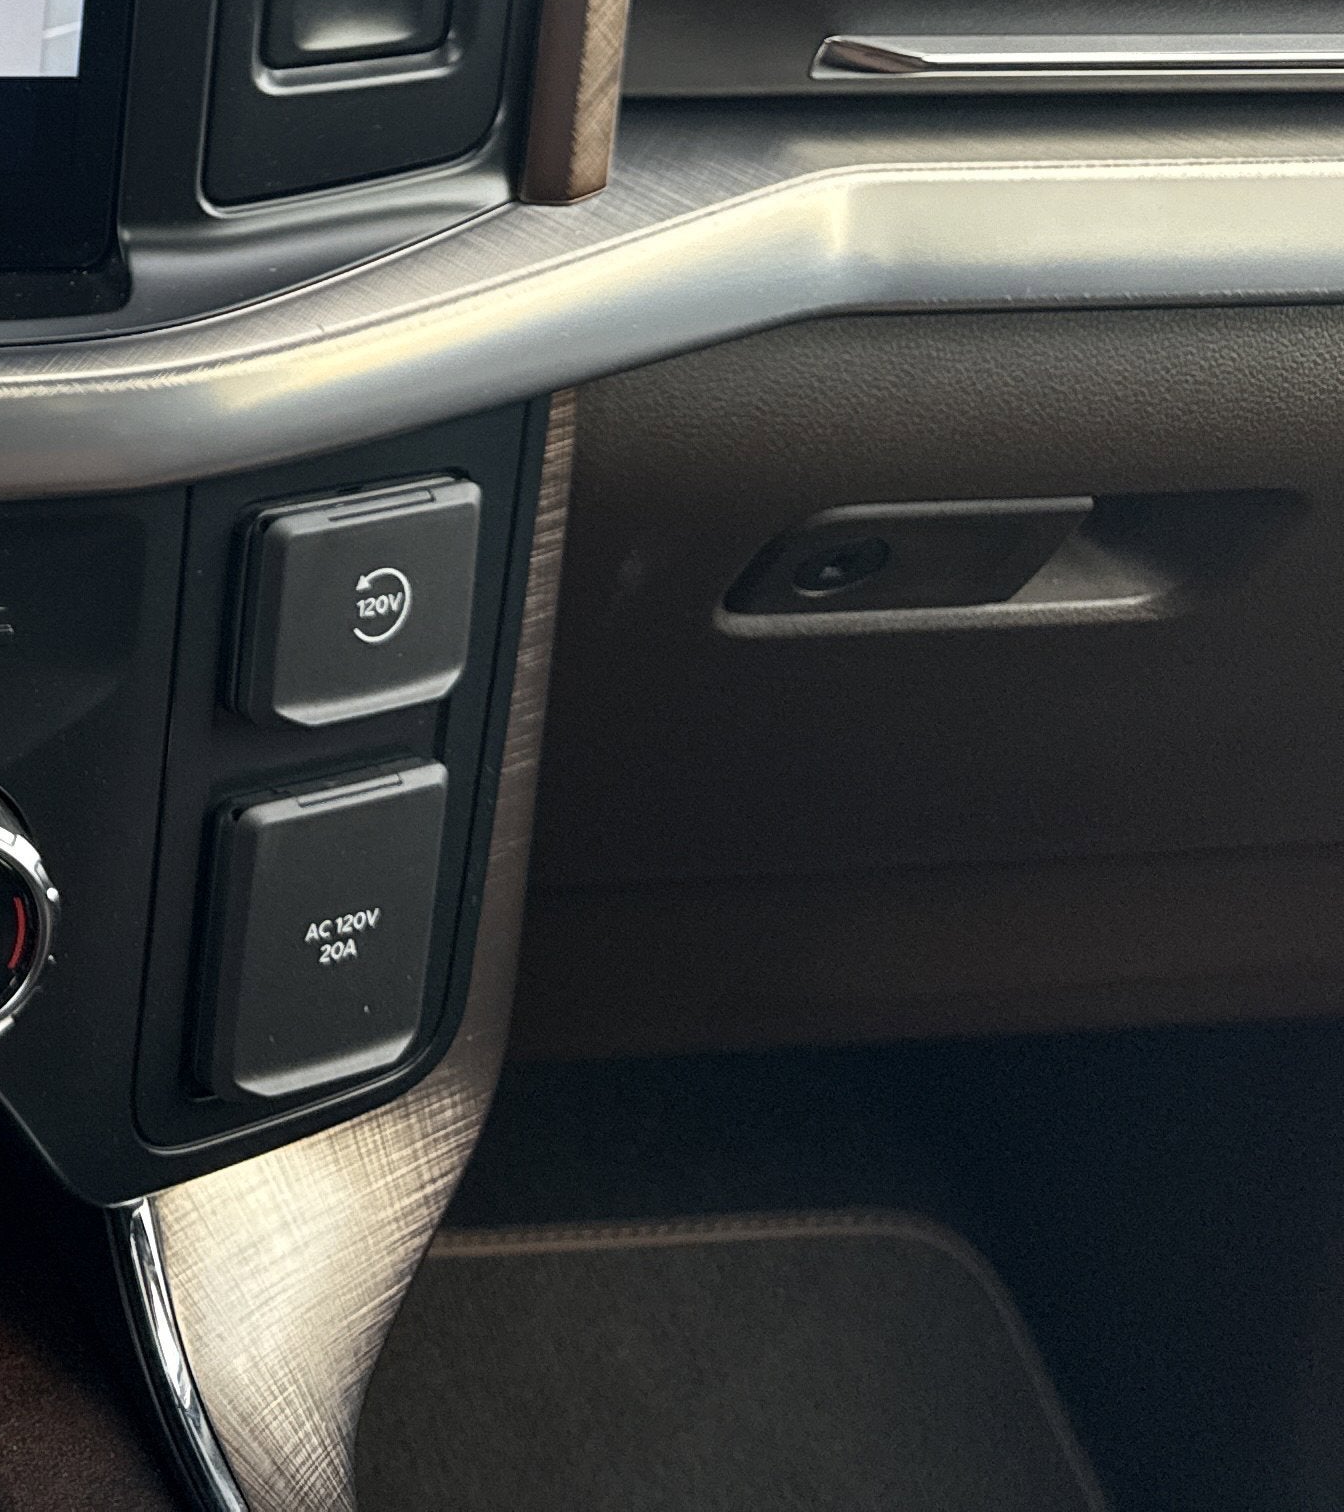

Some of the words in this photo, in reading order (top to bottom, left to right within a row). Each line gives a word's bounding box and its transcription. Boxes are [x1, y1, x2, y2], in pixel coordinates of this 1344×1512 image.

[355, 590, 405, 619] 120V
[304, 918, 333, 942] AC
[335, 907, 381, 935] 120V
[318, 939, 358, 964] 20A
